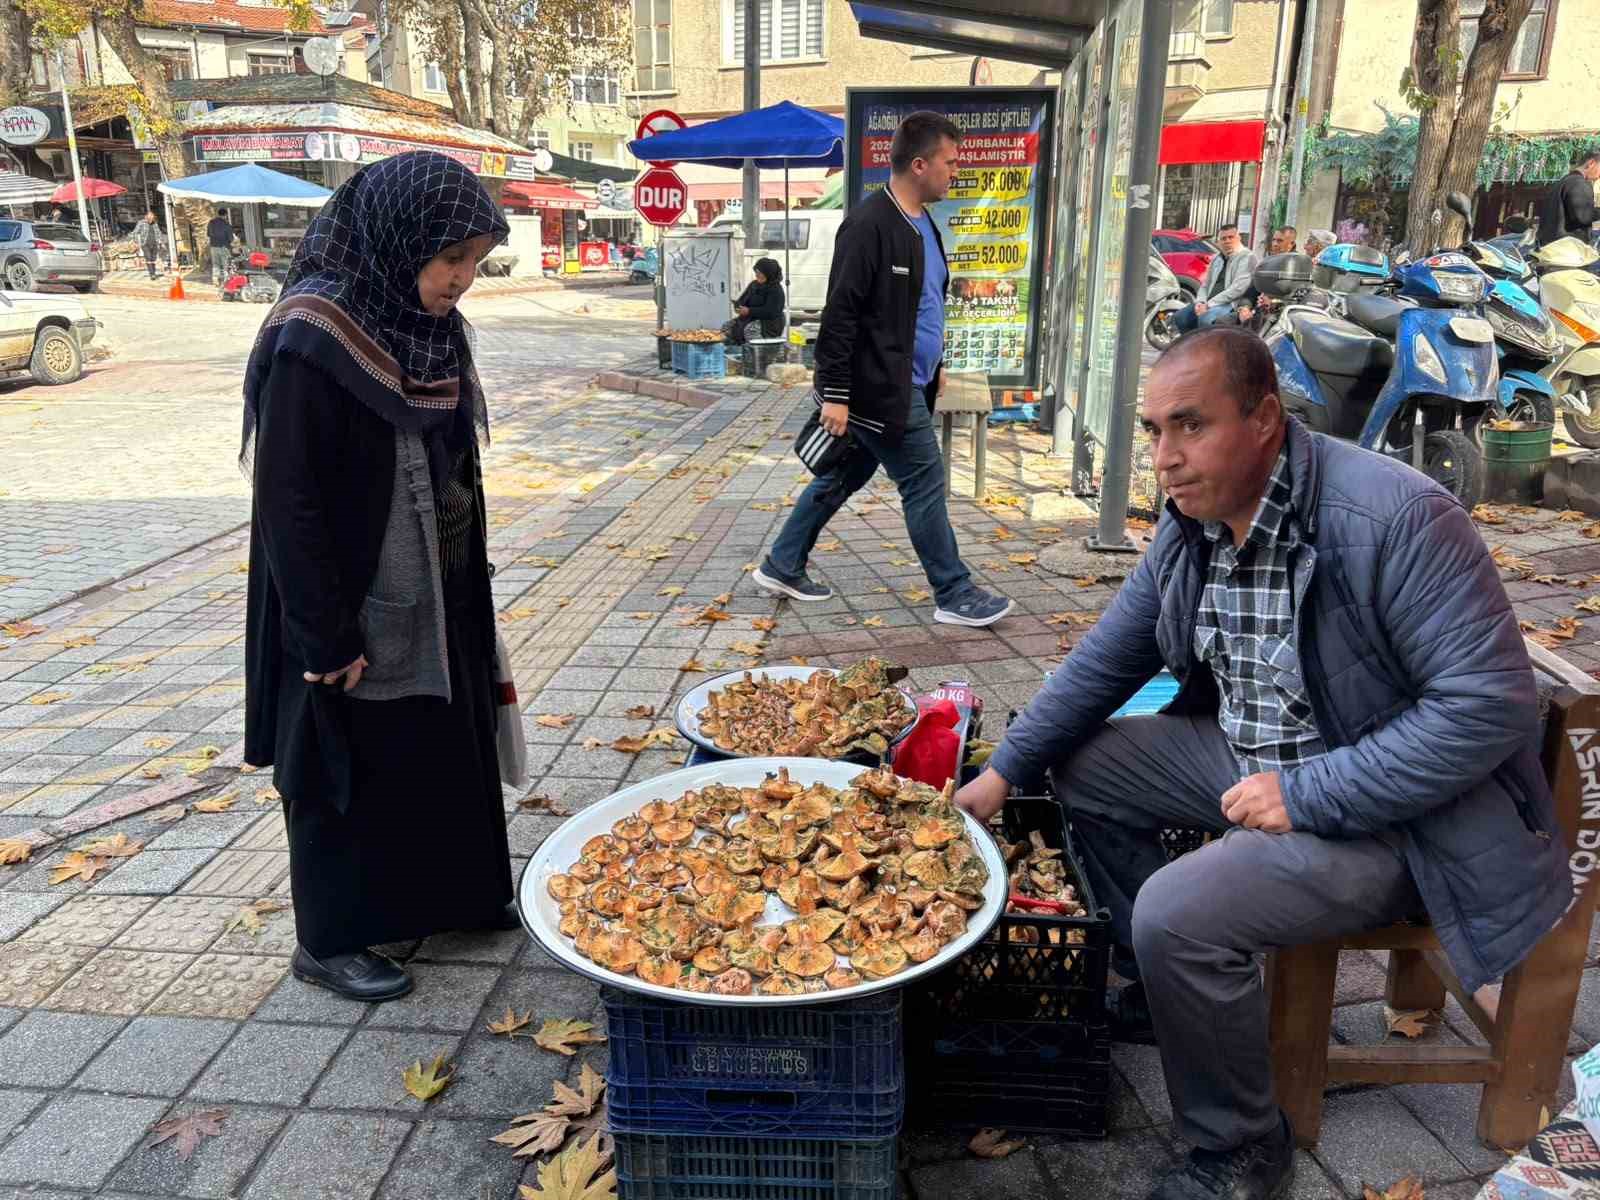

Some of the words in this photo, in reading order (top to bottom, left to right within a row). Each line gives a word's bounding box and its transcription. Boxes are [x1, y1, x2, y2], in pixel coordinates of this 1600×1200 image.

[982, 108, 999, 128] BESİ
[958, 150, 1025, 163] AŞLAMIŞTIR
[640, 187, 683, 209] DUR
[984, 209, 1021, 229] 42.000
[981, 245, 1019, 265] 52.000
[982, 294, 1019, 306] TAKSİT
[930, 688, 945, 700] 40
[947, 688, 965, 701] KG
[1566, 727, 1600, 821] ASRIN
